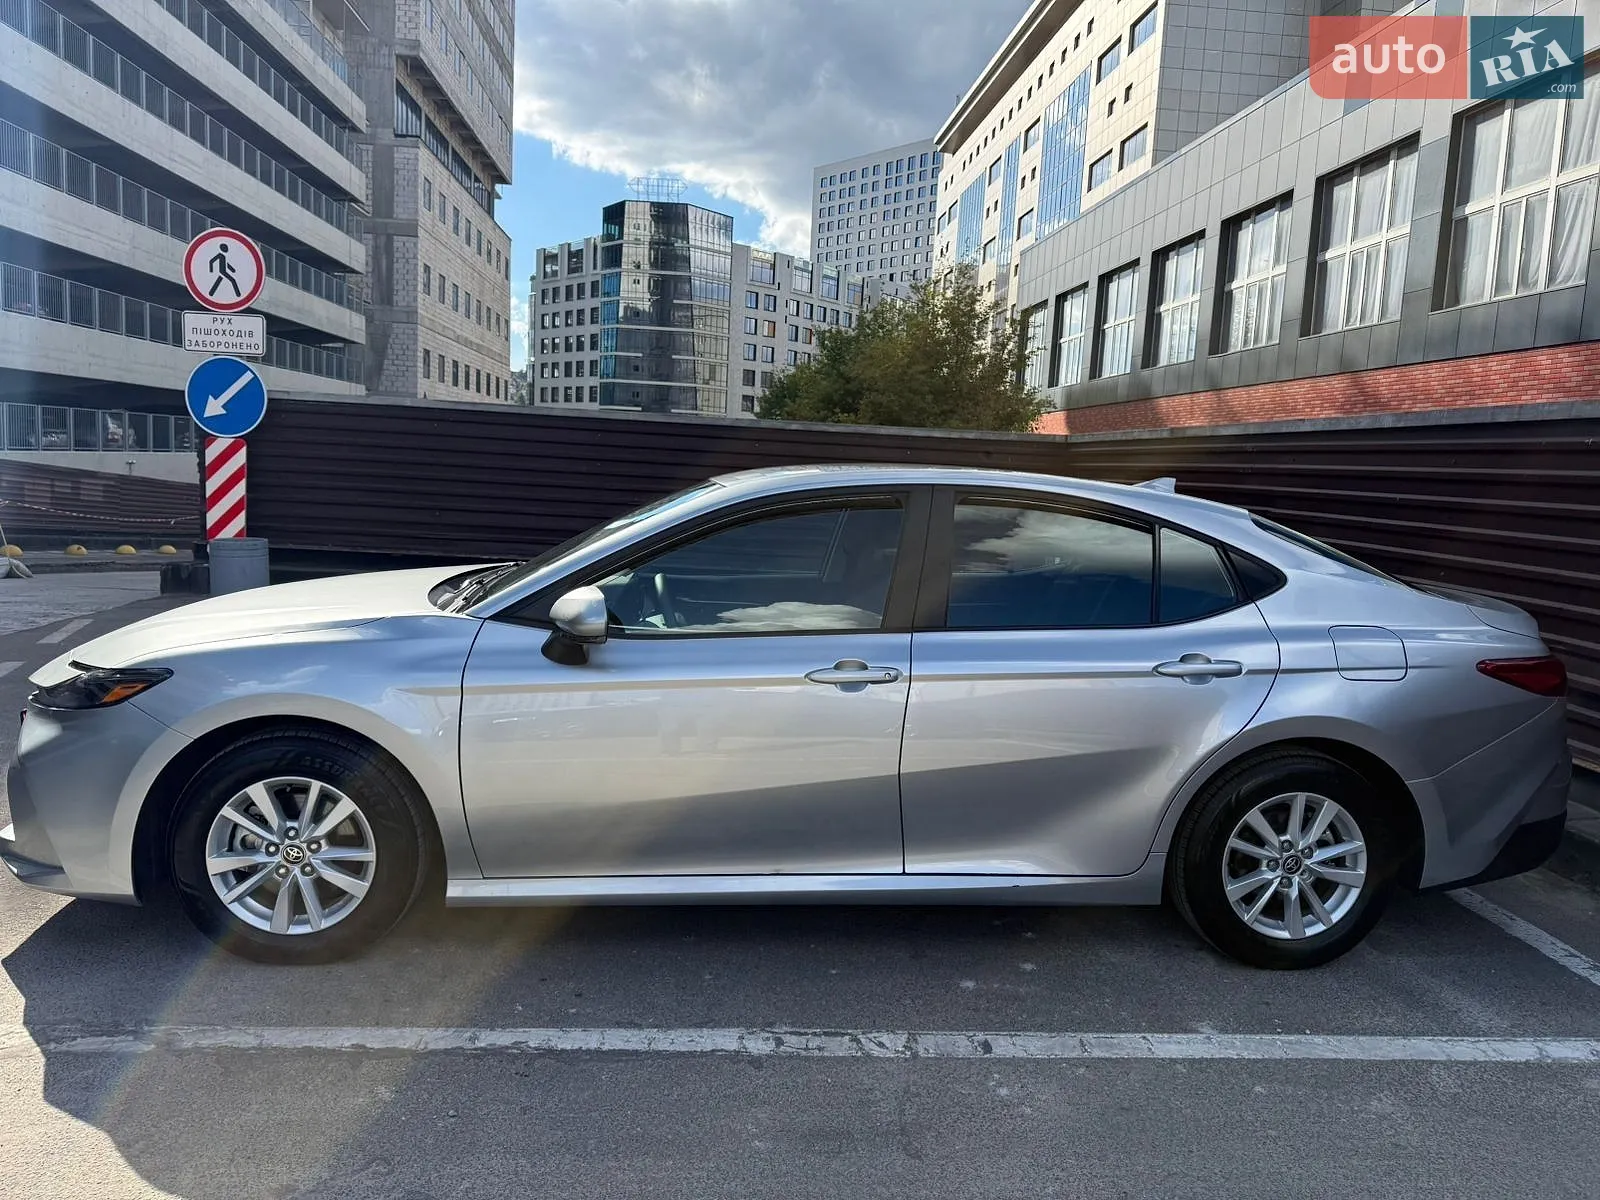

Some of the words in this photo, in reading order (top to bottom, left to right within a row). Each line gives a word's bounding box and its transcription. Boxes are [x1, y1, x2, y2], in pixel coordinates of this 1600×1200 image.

[212, 317, 233, 325] РУХ
[192, 327, 254, 338] ПІШОХОДІВ
[187, 339, 260, 351] ЗАБОРОНЕНО
